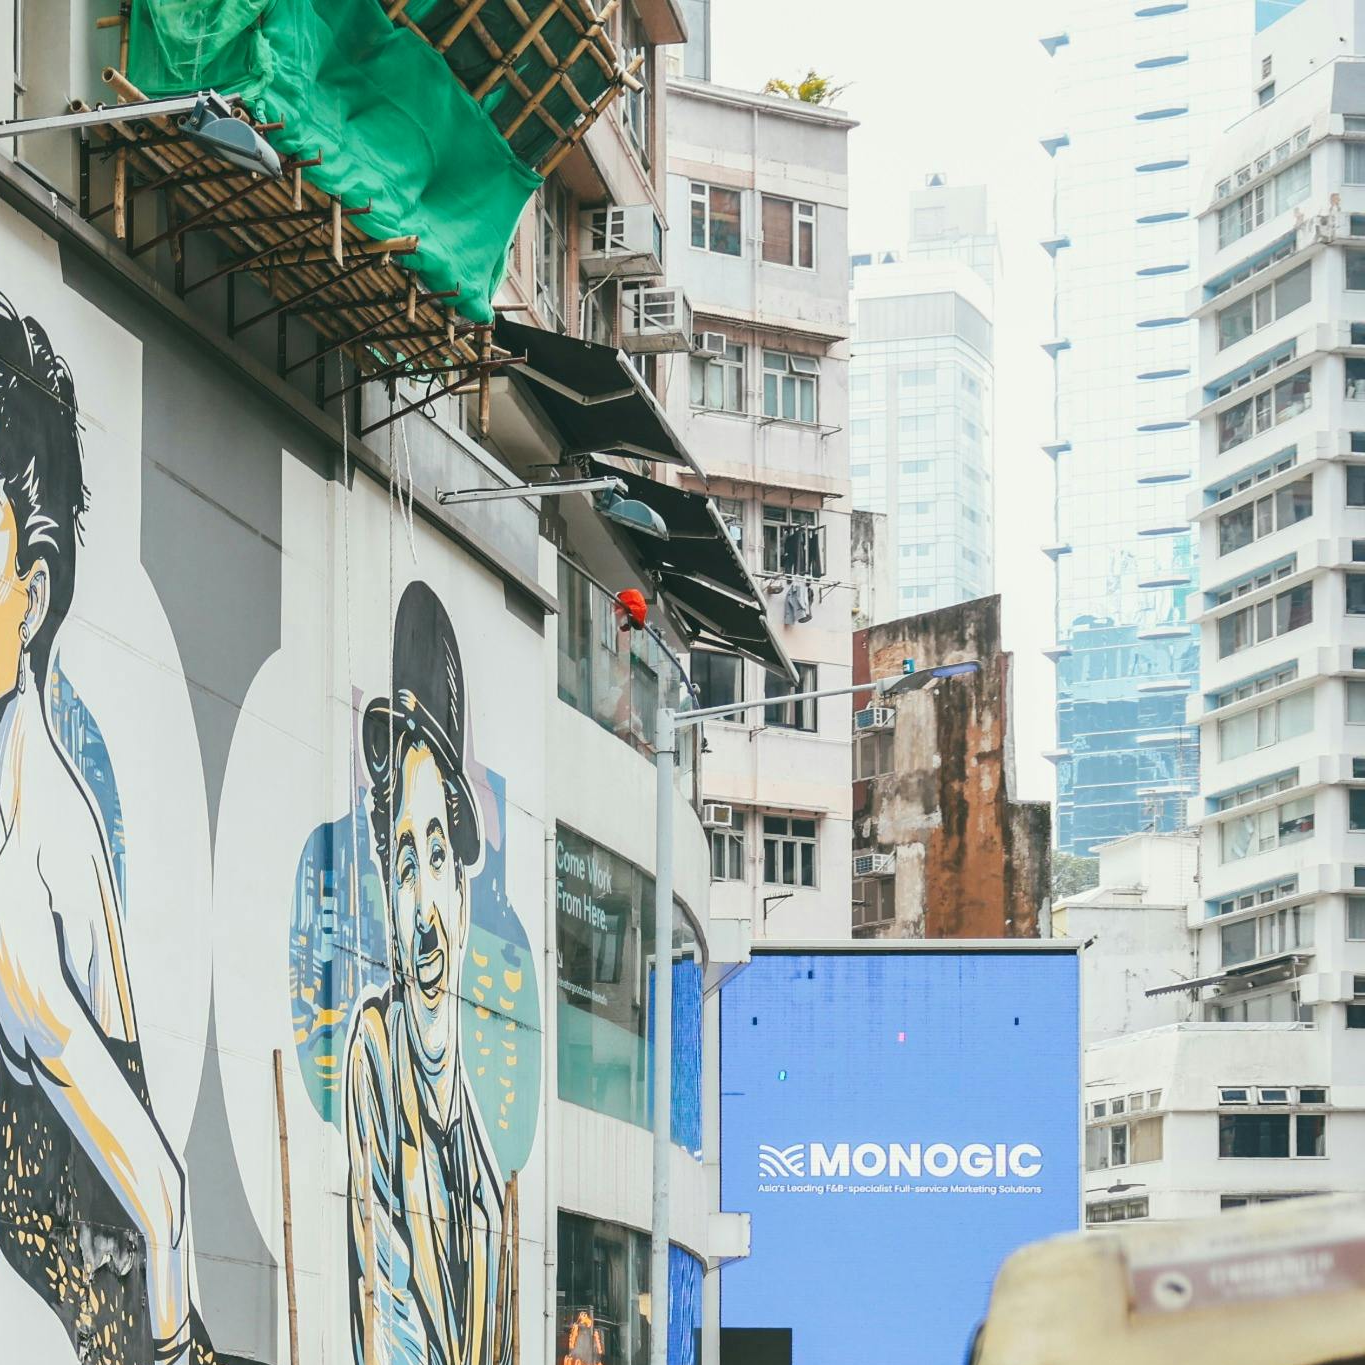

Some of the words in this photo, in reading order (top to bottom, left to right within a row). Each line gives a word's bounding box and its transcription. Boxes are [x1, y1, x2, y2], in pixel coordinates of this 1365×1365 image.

[556, 840, 585, 880] Come
[587, 855, 612, 894] Work
[556, 881, 582, 921] From
[809, 1142, 1043, 1178] MONOGIC
[758, 1184, 785, 1193] Asia's
[787, 1184, 824, 1195] Leading
[825, 1184, 893, 1195] F&B-specialist
[894, 1184, 948, 1194] Full-service
[950, 1184, 997, 1196] Marketing
[999, 1185, 1042, 1194] Solutions
